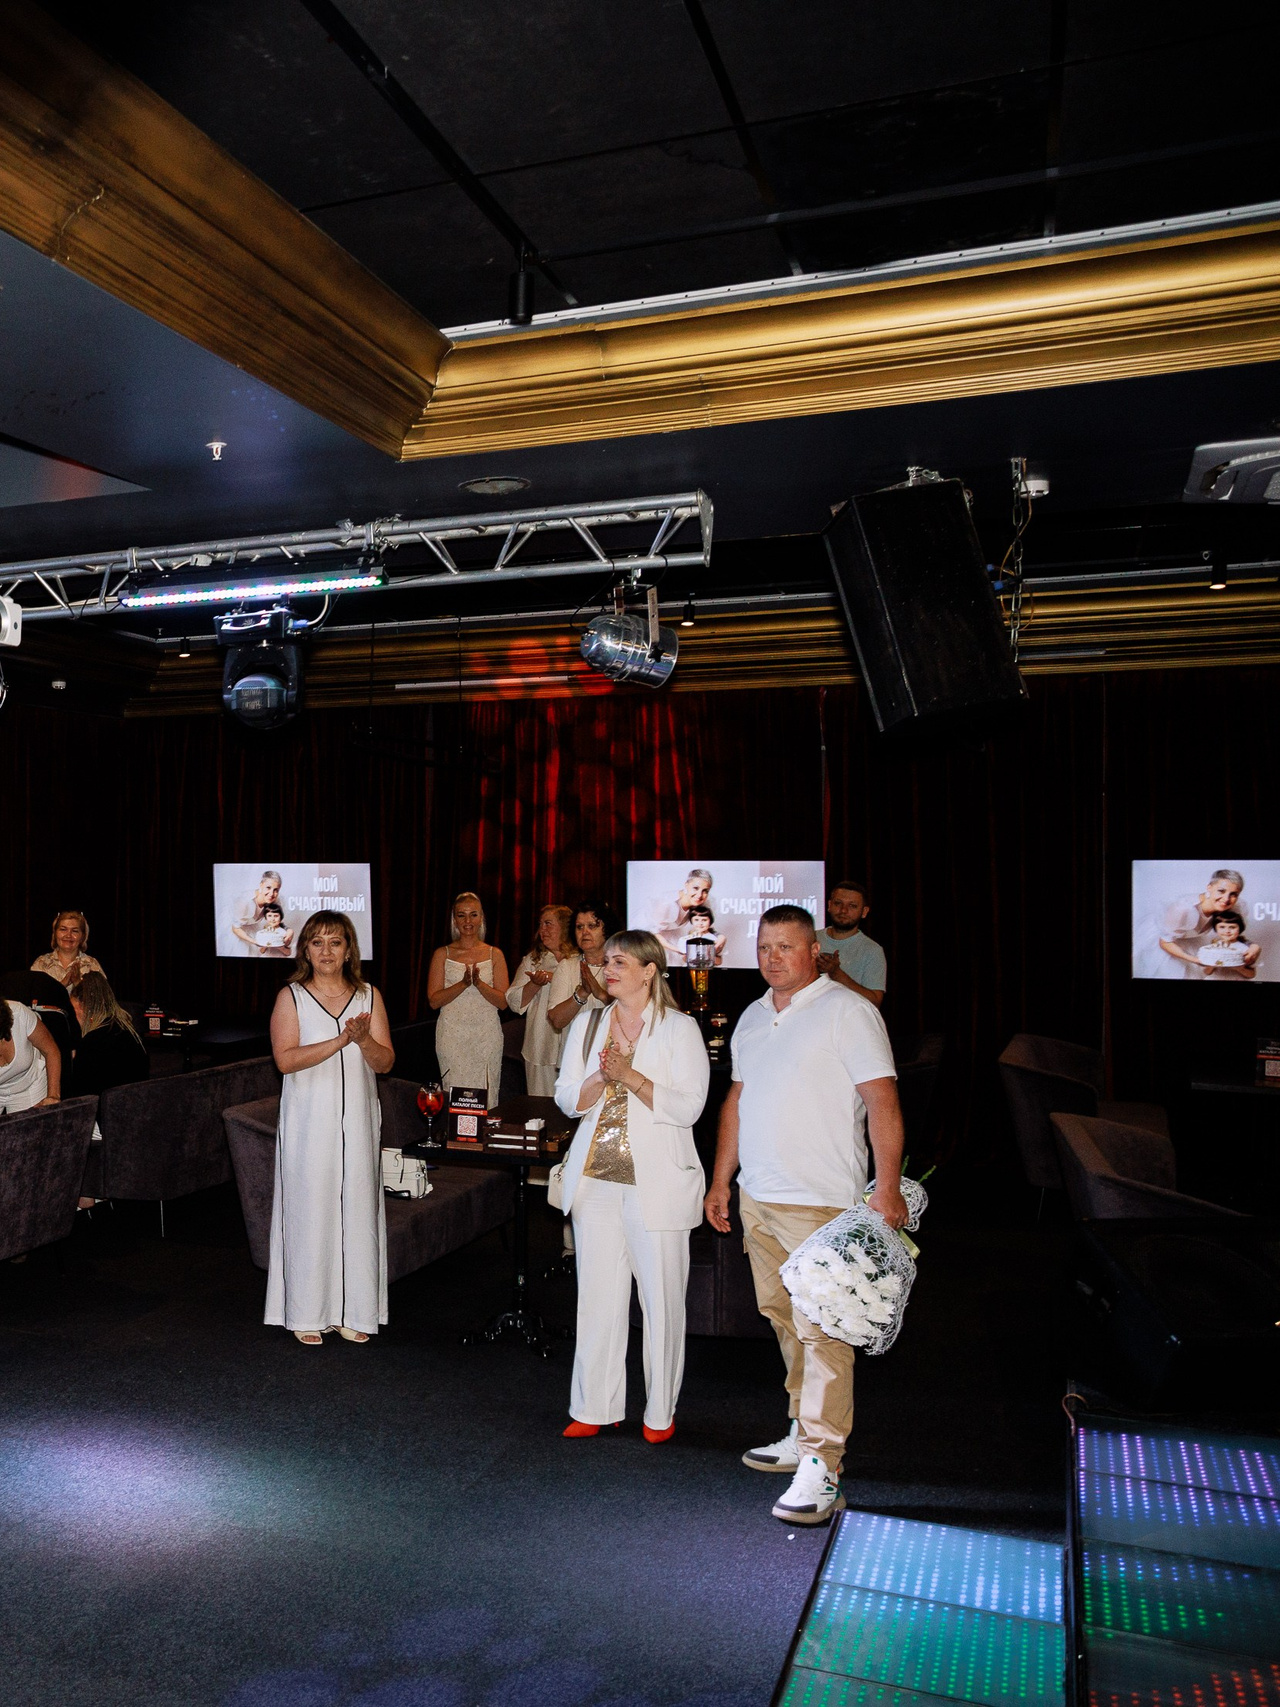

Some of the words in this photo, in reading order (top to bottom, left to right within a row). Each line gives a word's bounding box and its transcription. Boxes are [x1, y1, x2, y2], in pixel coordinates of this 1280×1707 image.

[313, 874, 338, 892] МОЙ
[752, 873, 784, 893] МОЙ
[288, 894, 365, 912] СЧАСТЛИВЫЙ
